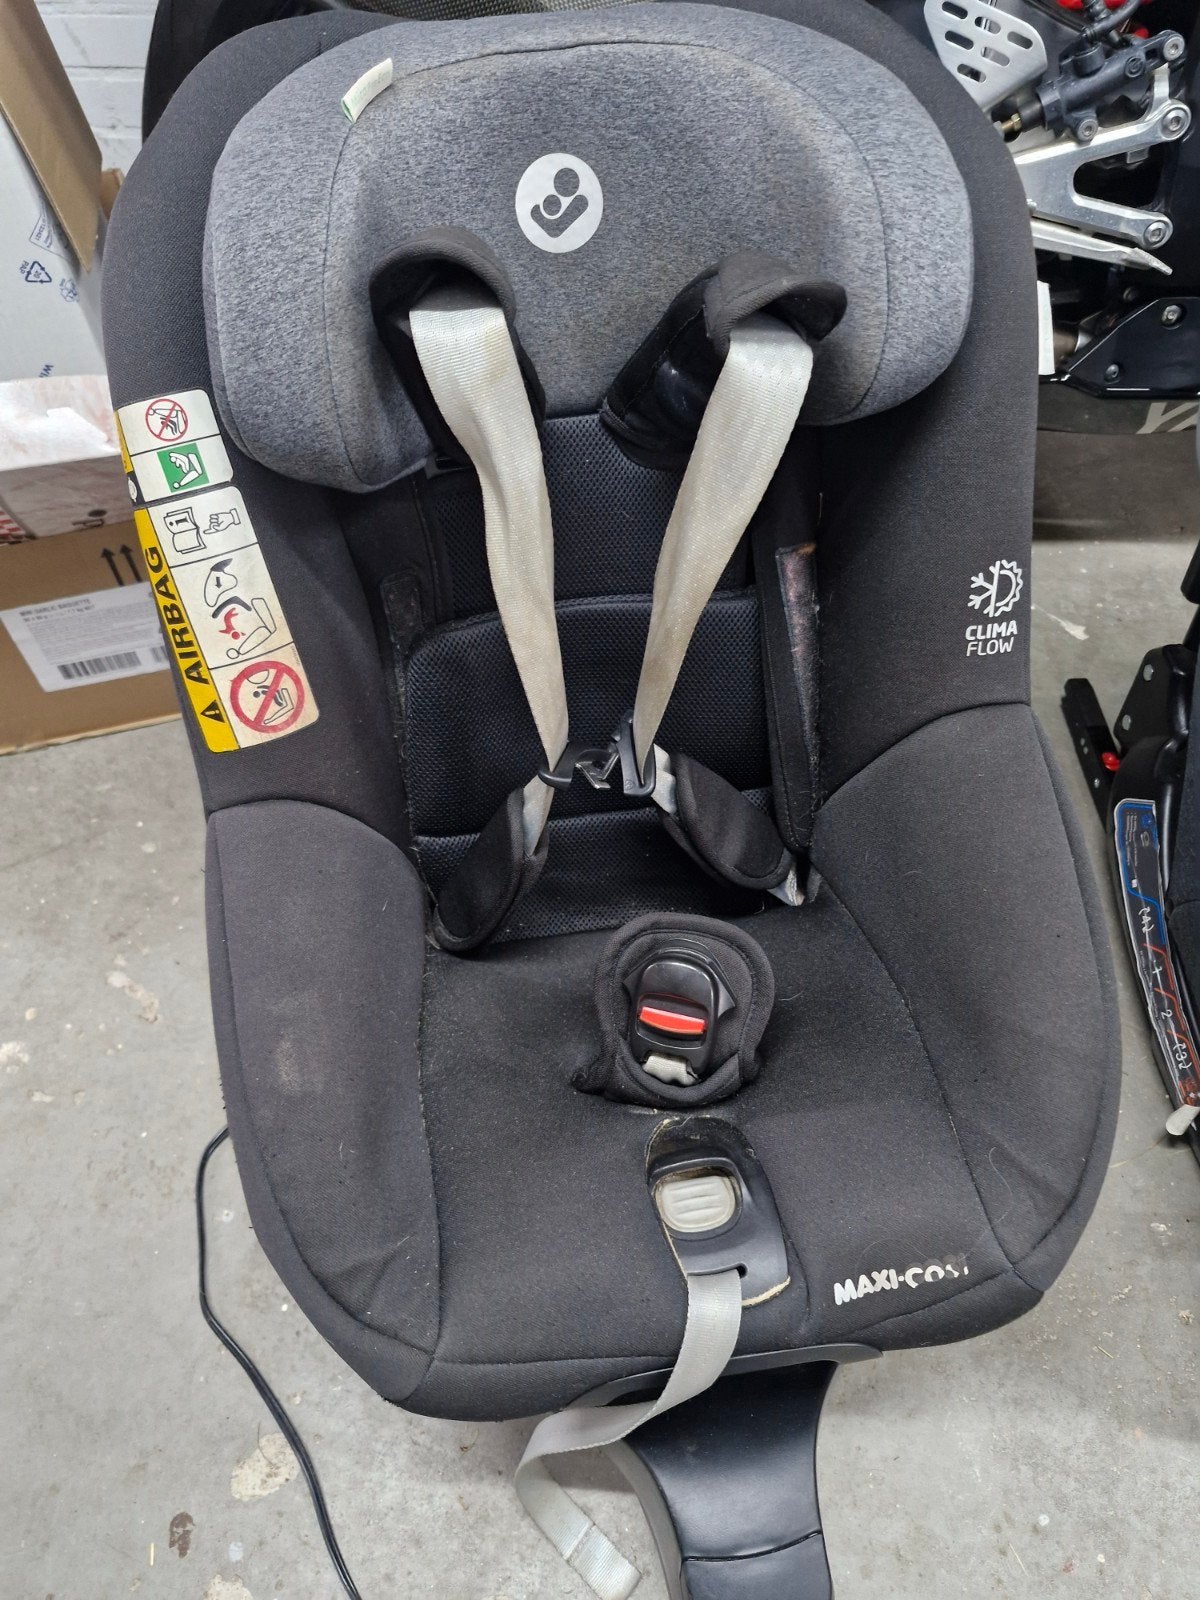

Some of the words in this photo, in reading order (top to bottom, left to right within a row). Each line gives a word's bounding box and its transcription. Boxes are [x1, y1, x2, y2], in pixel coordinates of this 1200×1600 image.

[20, 260, 30, 274] PAP
[145, 546, 209, 685] AIRBAG
[965, 620, 1018, 640] CLIMA
[966, 637, 1014, 656] FLOW
[1161, 1009, 1173, 1020] 2
